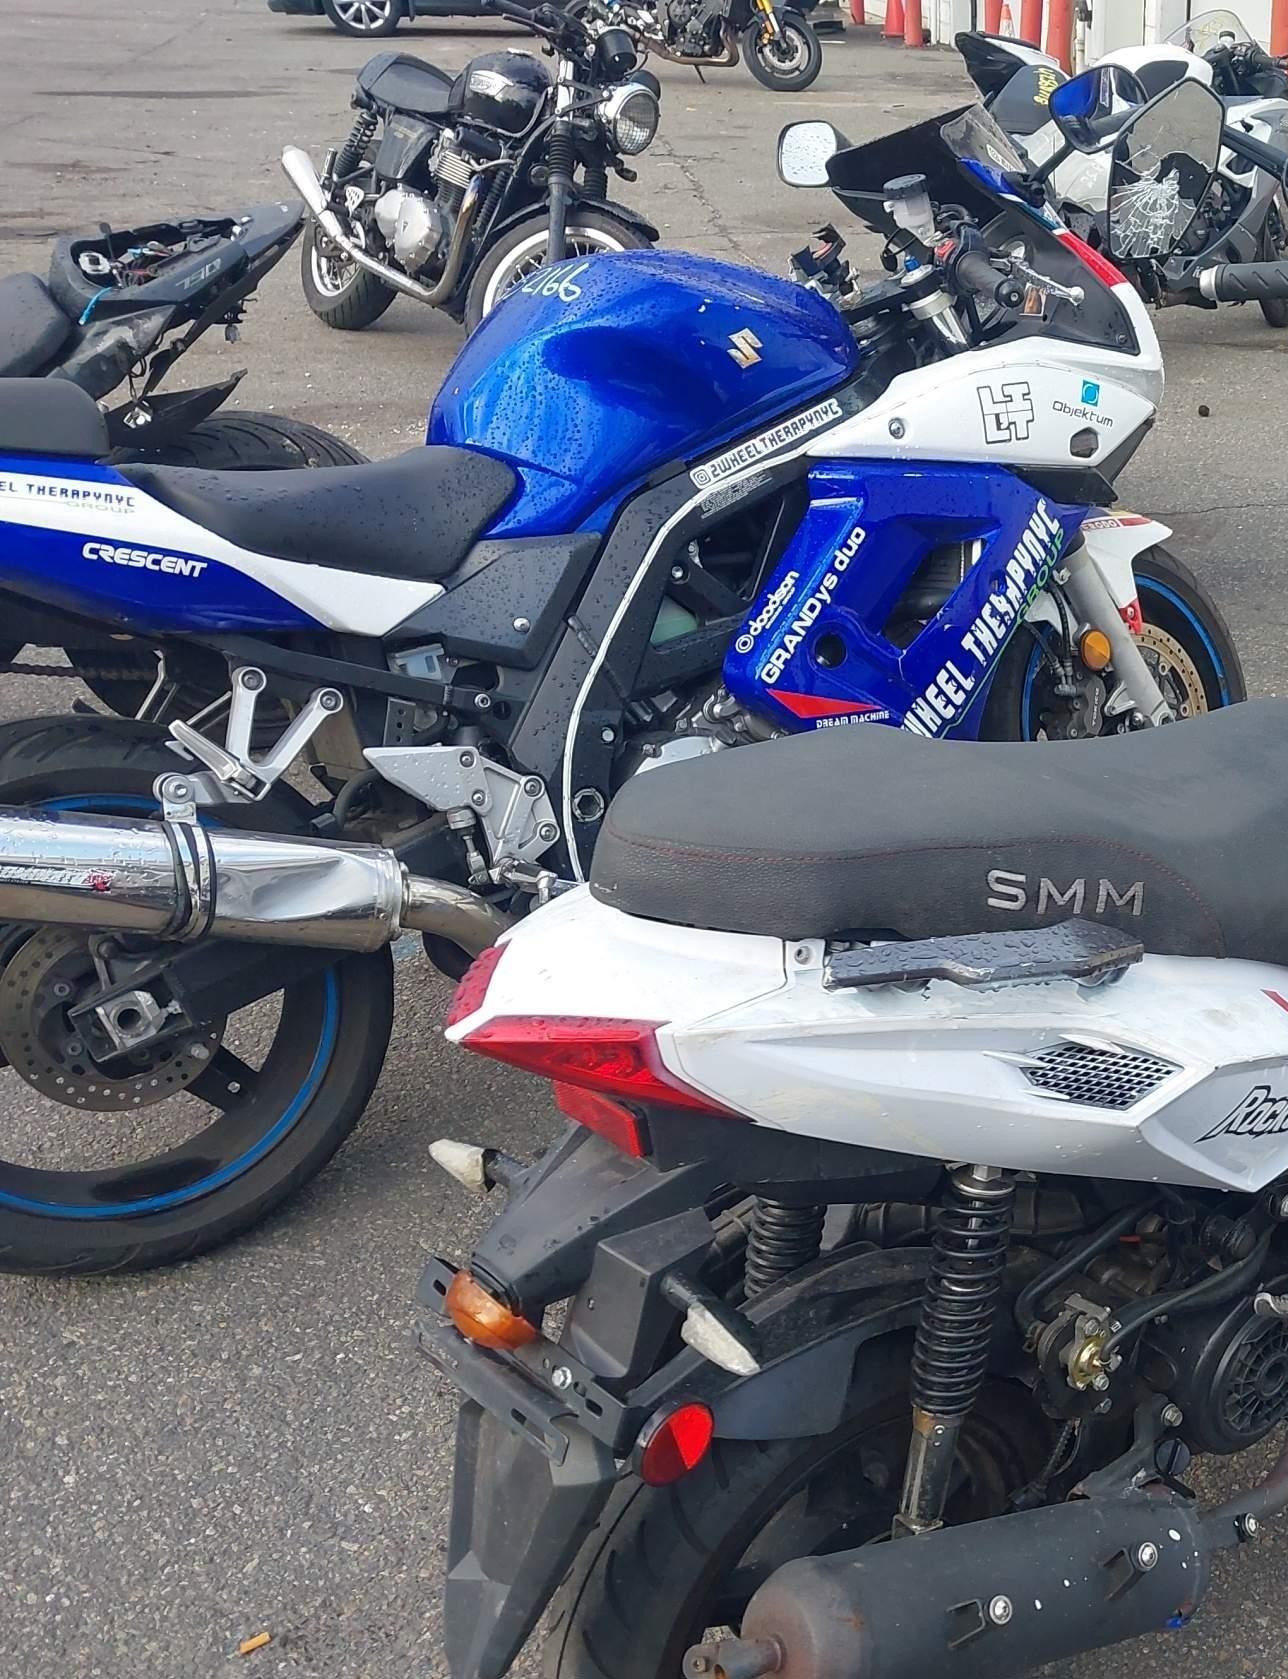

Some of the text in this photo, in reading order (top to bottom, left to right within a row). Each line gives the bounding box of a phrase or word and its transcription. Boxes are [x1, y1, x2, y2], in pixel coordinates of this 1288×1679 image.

[1052, 400, 1114, 427] Objektum
[26, 483, 135, 507] THERAPYNYC
[64, 500, 135, 514] GROUP
[82, 542, 208, 578] CRESCENT
[1016, 527, 1064, 625] GROUP
[749, 570, 800, 637] doodson
[760, 572, 839, 684] GRANDys
[834, 526, 867, 572] duo
[816, 710, 890, 729] DREAM MACHINE
[986, 869, 1145, 916] SMM
